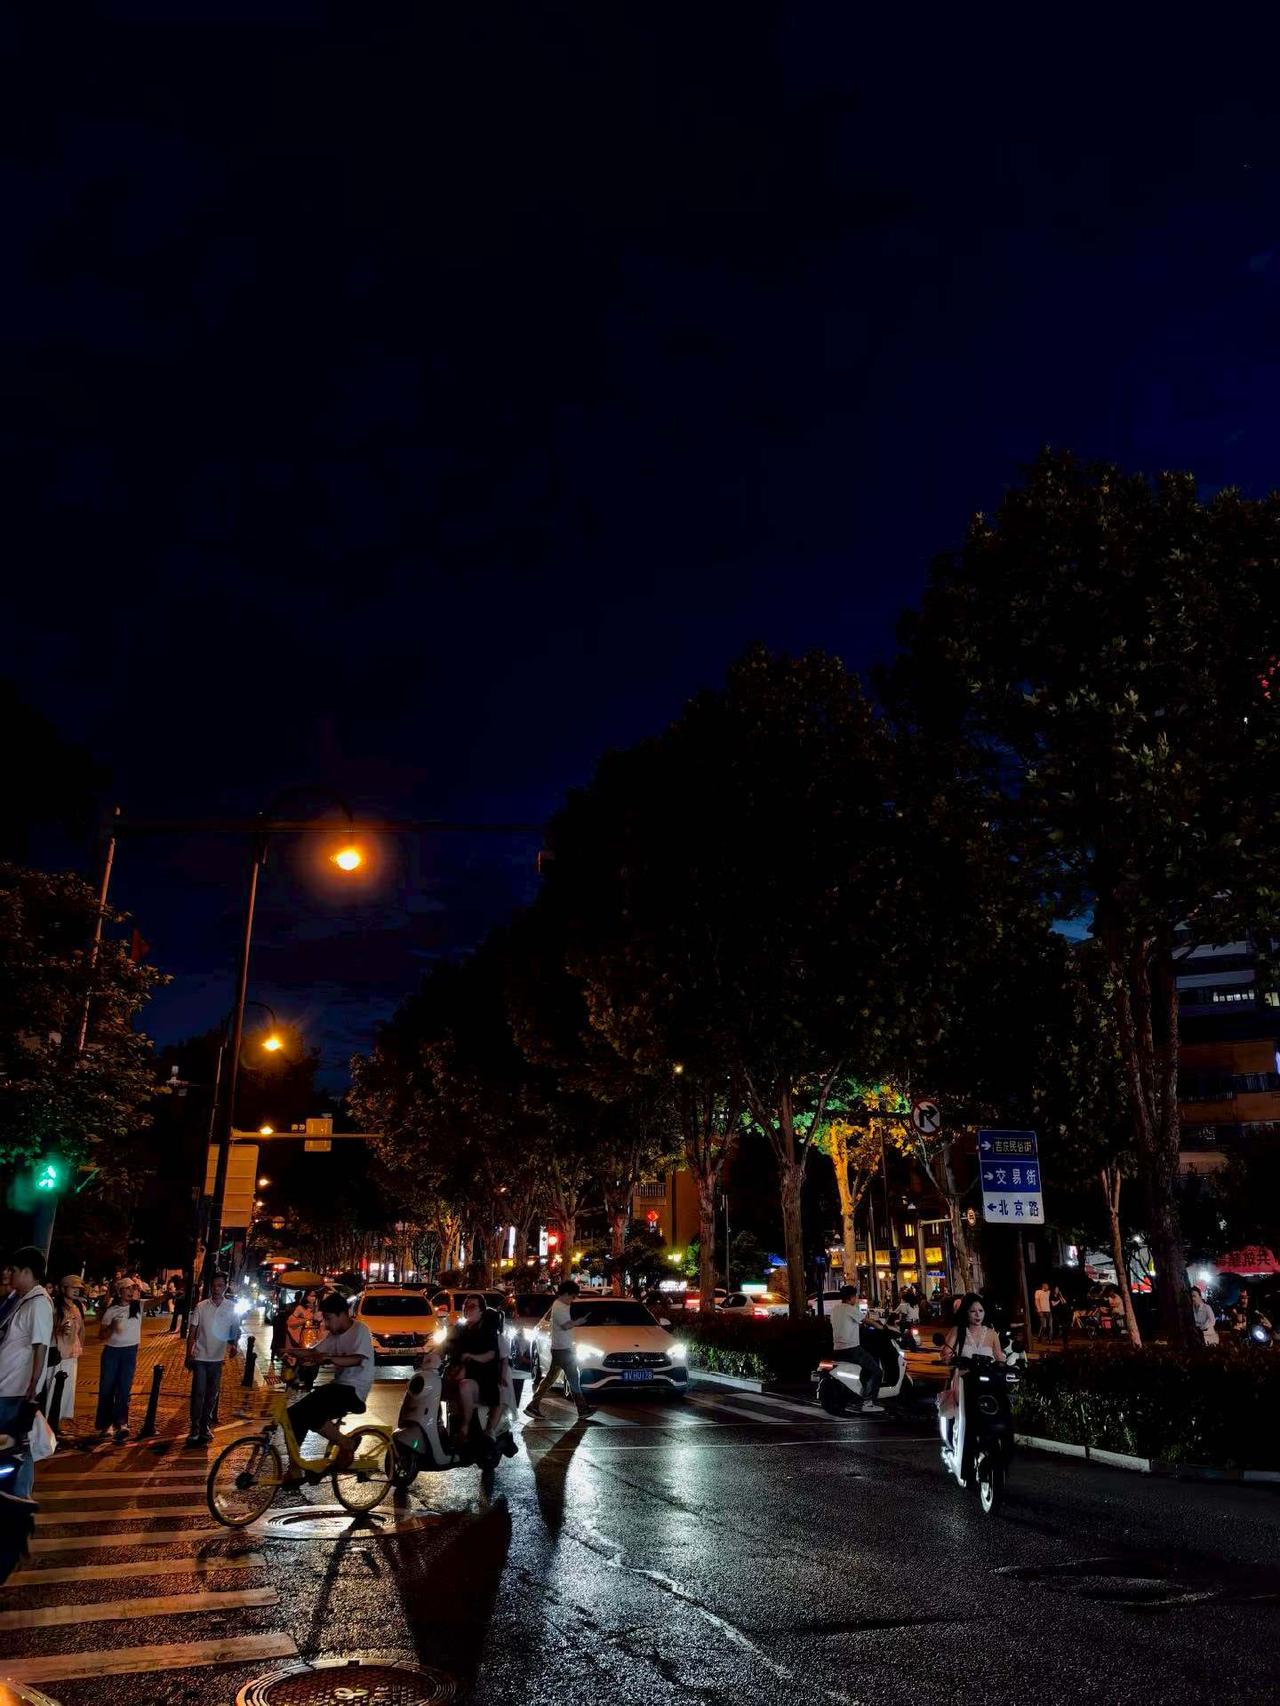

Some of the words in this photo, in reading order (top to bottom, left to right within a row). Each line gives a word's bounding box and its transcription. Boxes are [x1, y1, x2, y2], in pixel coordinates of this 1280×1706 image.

[995, 1168, 1036, 1185] 交易街
[999, 1199, 1039, 1216] 北京路
